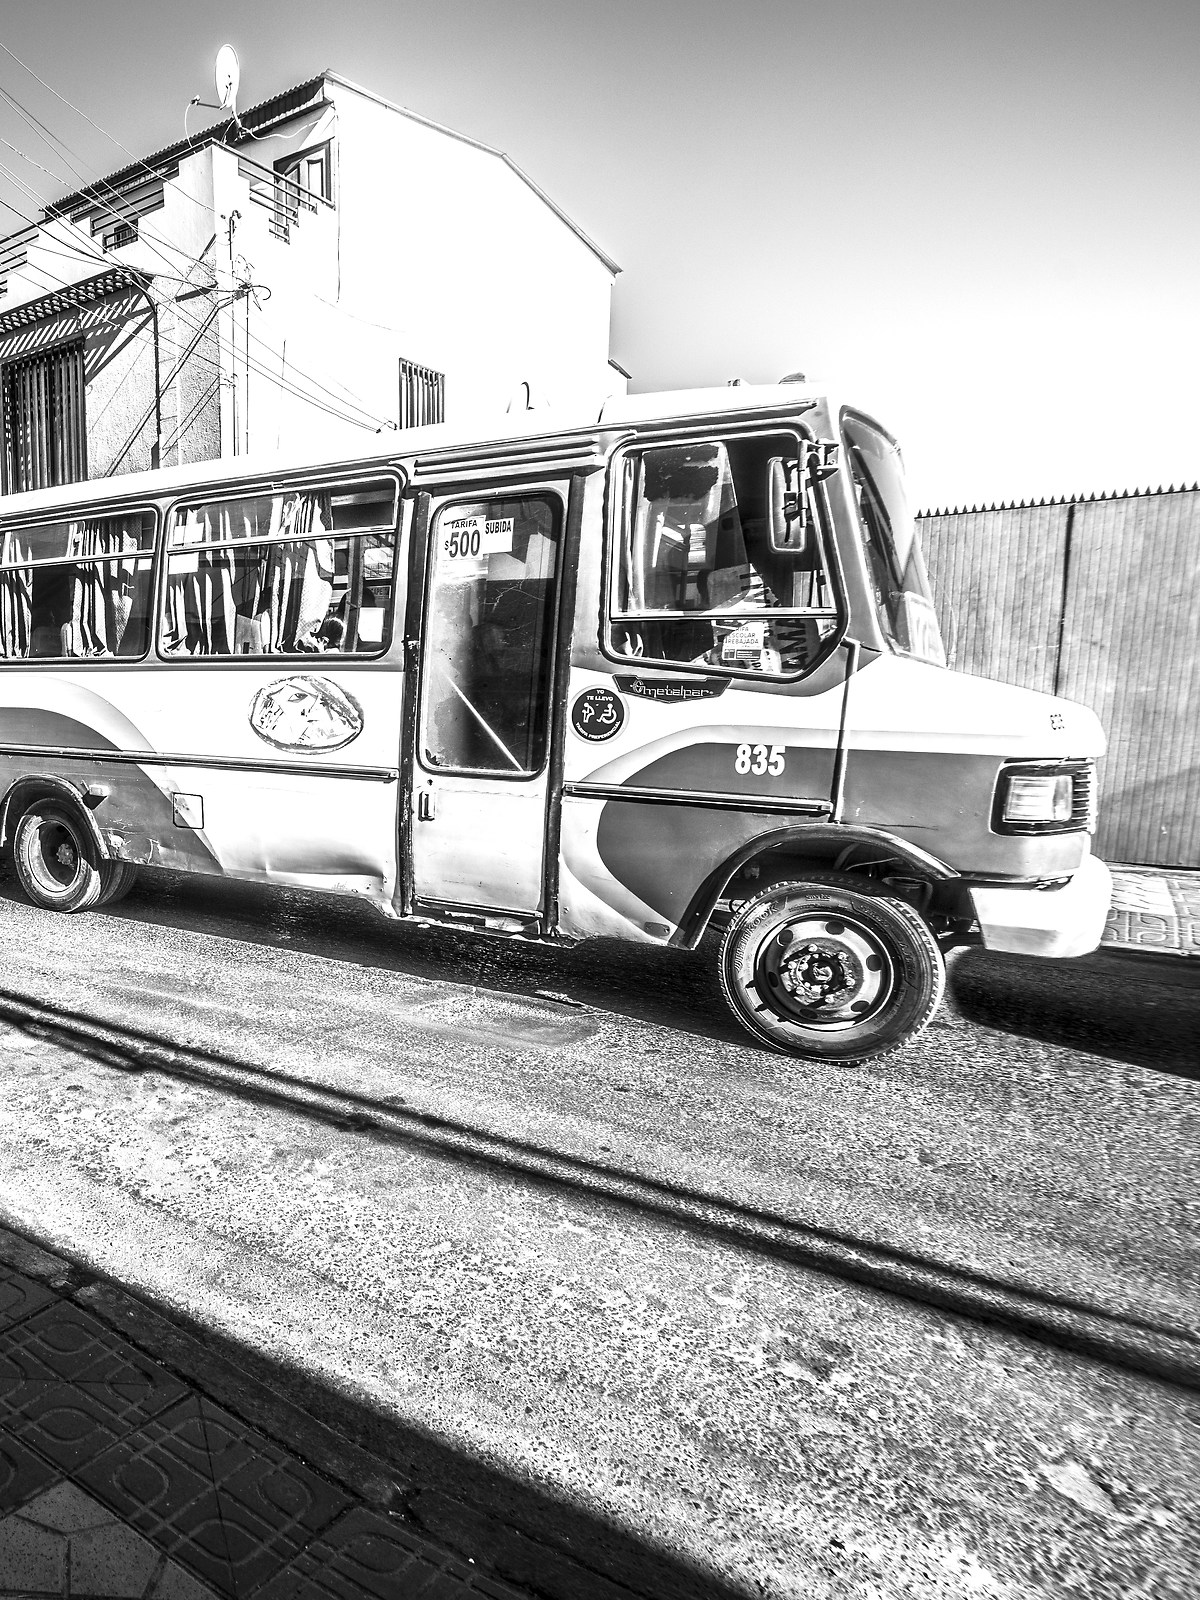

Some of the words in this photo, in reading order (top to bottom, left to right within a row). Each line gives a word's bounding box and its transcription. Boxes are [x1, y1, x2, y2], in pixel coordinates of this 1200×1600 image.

[451, 520, 478, 529] TARIFA
[485, 520, 512, 534] SUBIDA
[444, 529, 481, 558] $500
[735, 743, 786, 777] 835
